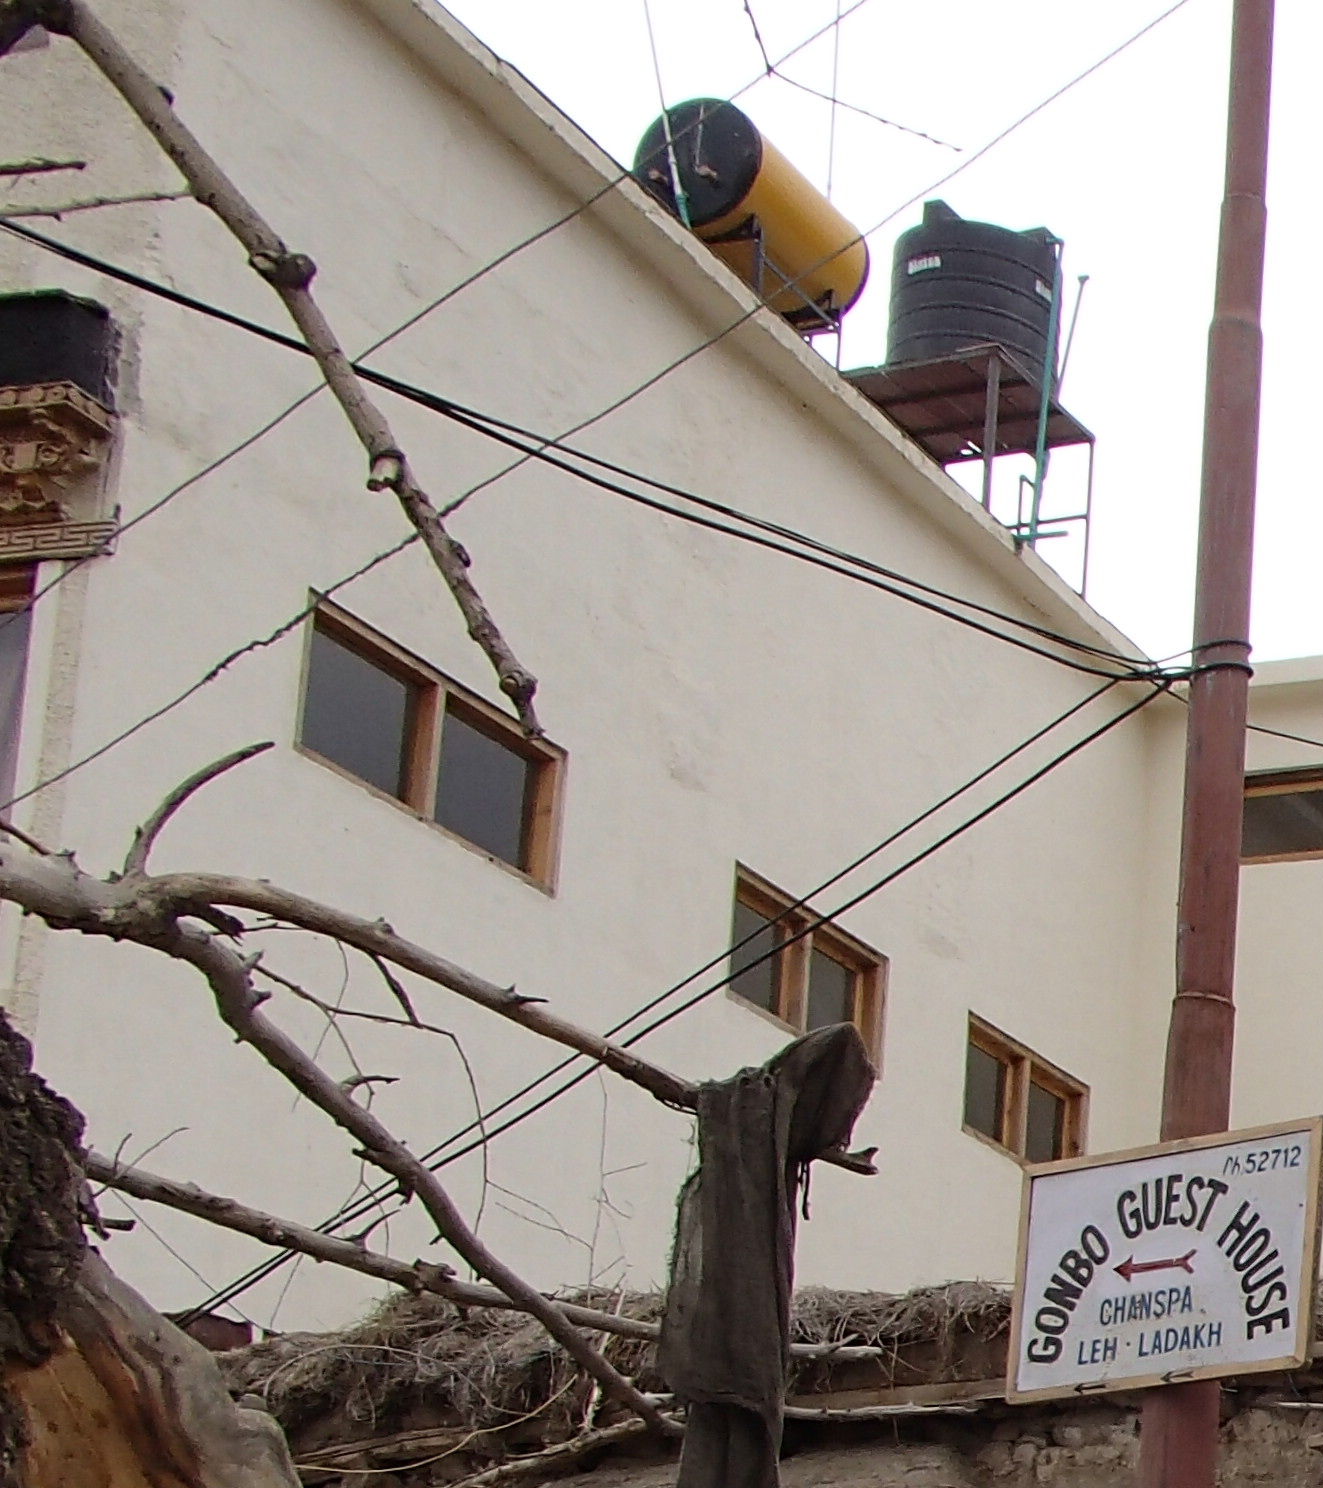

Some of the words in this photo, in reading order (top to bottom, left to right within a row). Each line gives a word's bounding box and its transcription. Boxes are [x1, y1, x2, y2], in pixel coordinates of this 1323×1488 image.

[1027, 1224, 1111, 1364] GONBO
[1116, 1173, 1229, 1240] GUEST
[1216, 1200, 1291, 1341] HOUSE
[1100, 1285, 1193, 1326] CHANSPA
[1077, 1335, 1118, 1365] LEH
[1138, 1322, 1222, 1357] LADAKH
